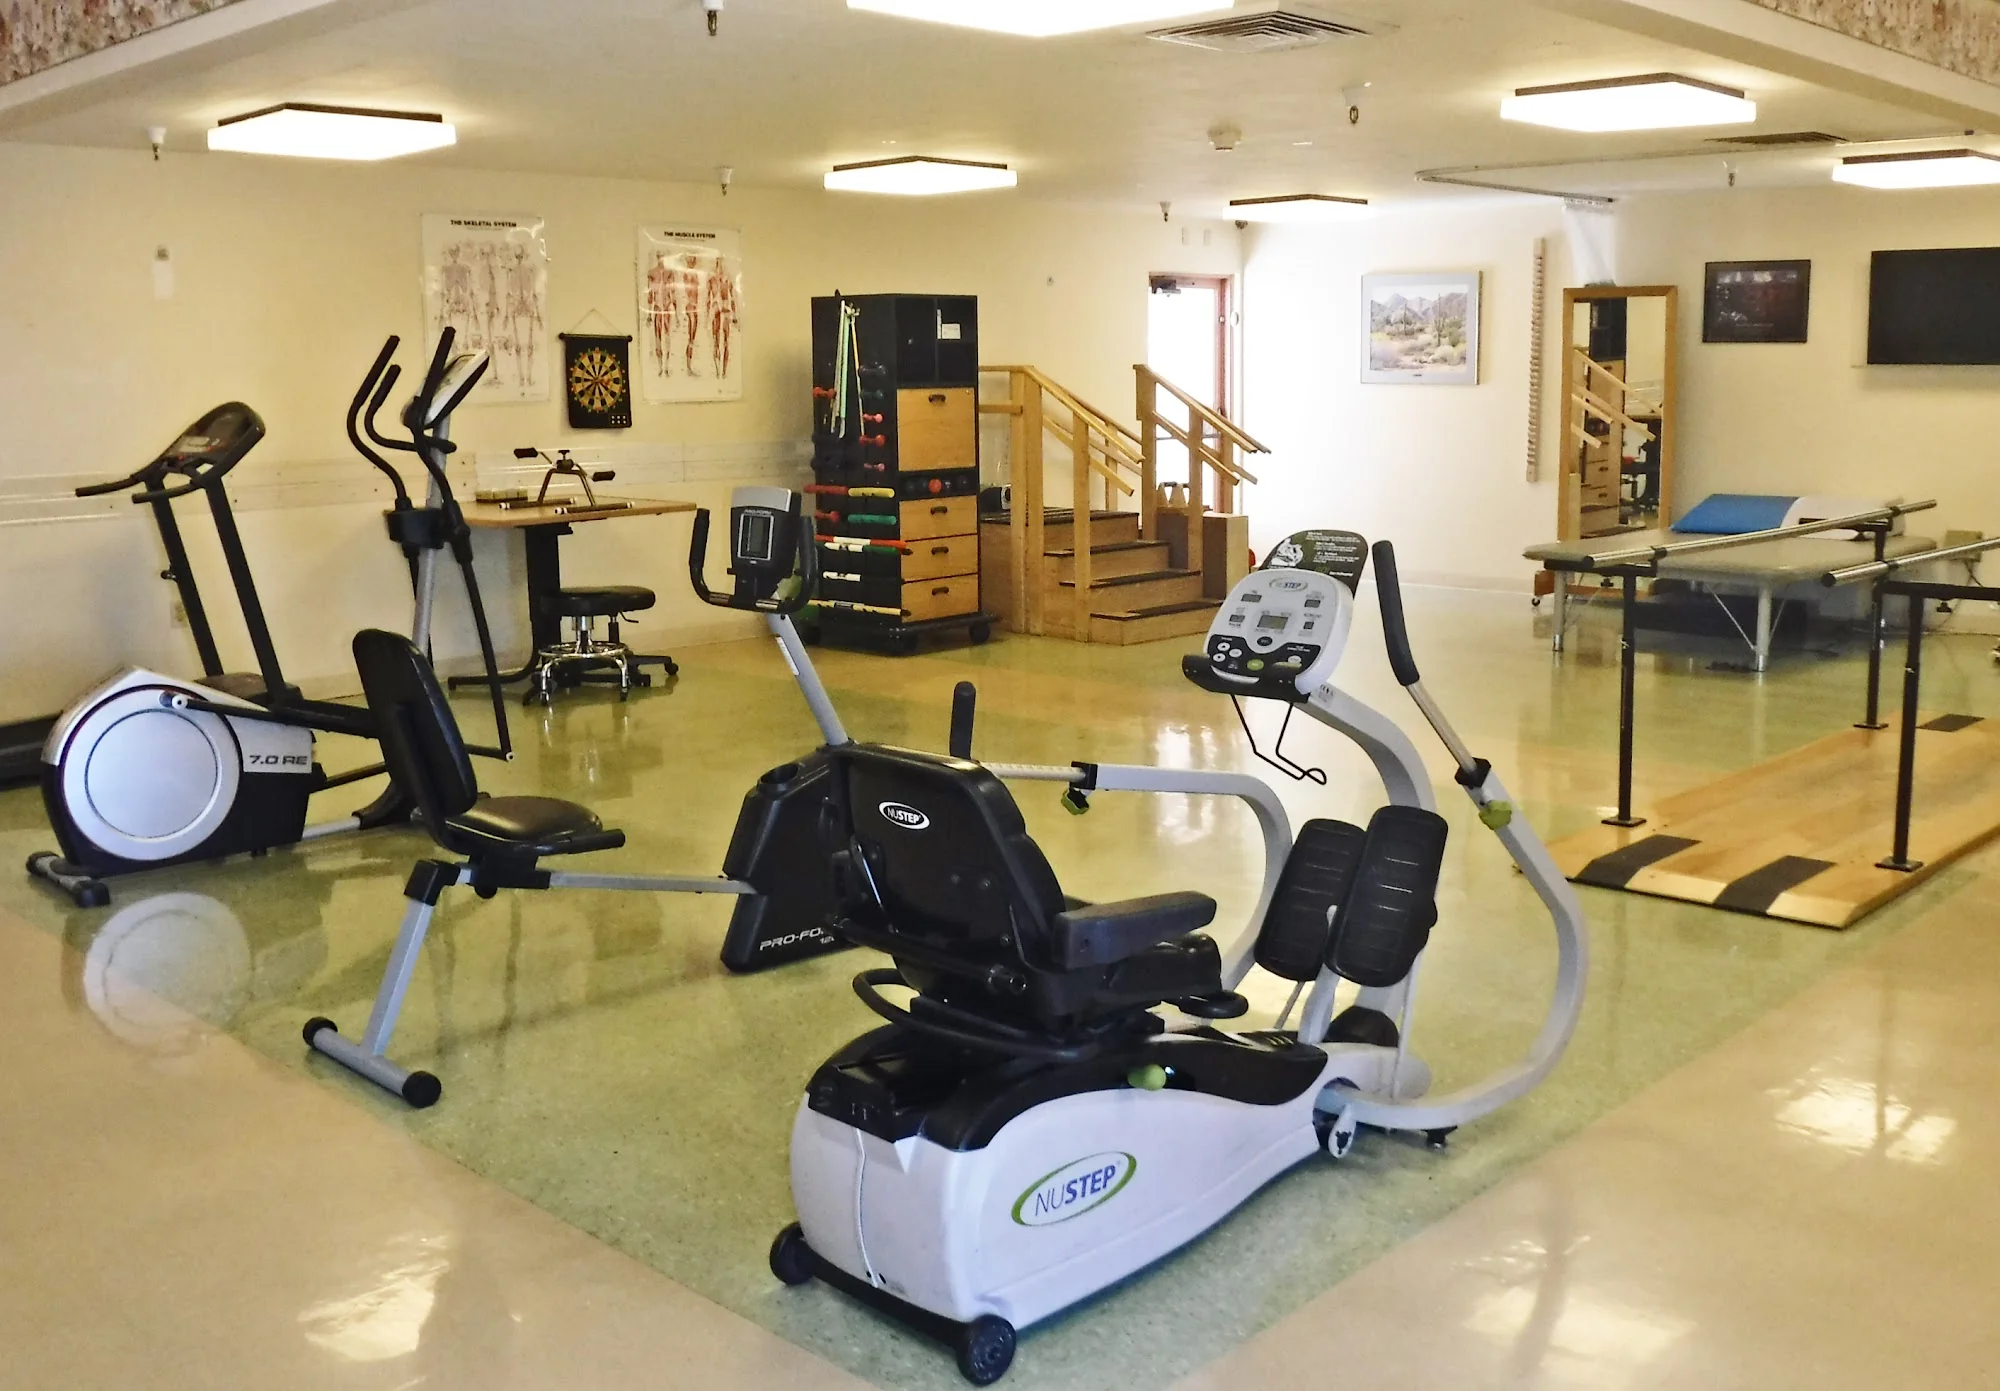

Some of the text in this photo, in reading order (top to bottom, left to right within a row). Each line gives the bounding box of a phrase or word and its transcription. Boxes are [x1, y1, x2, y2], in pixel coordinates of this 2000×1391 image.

[249, 754, 308, 765] 7.0 RE
[887, 806, 920, 824] NUSTEP
[760, 927, 824, 951] PRO-FO
[1035, 1164, 1116, 1216] NUSTEP
